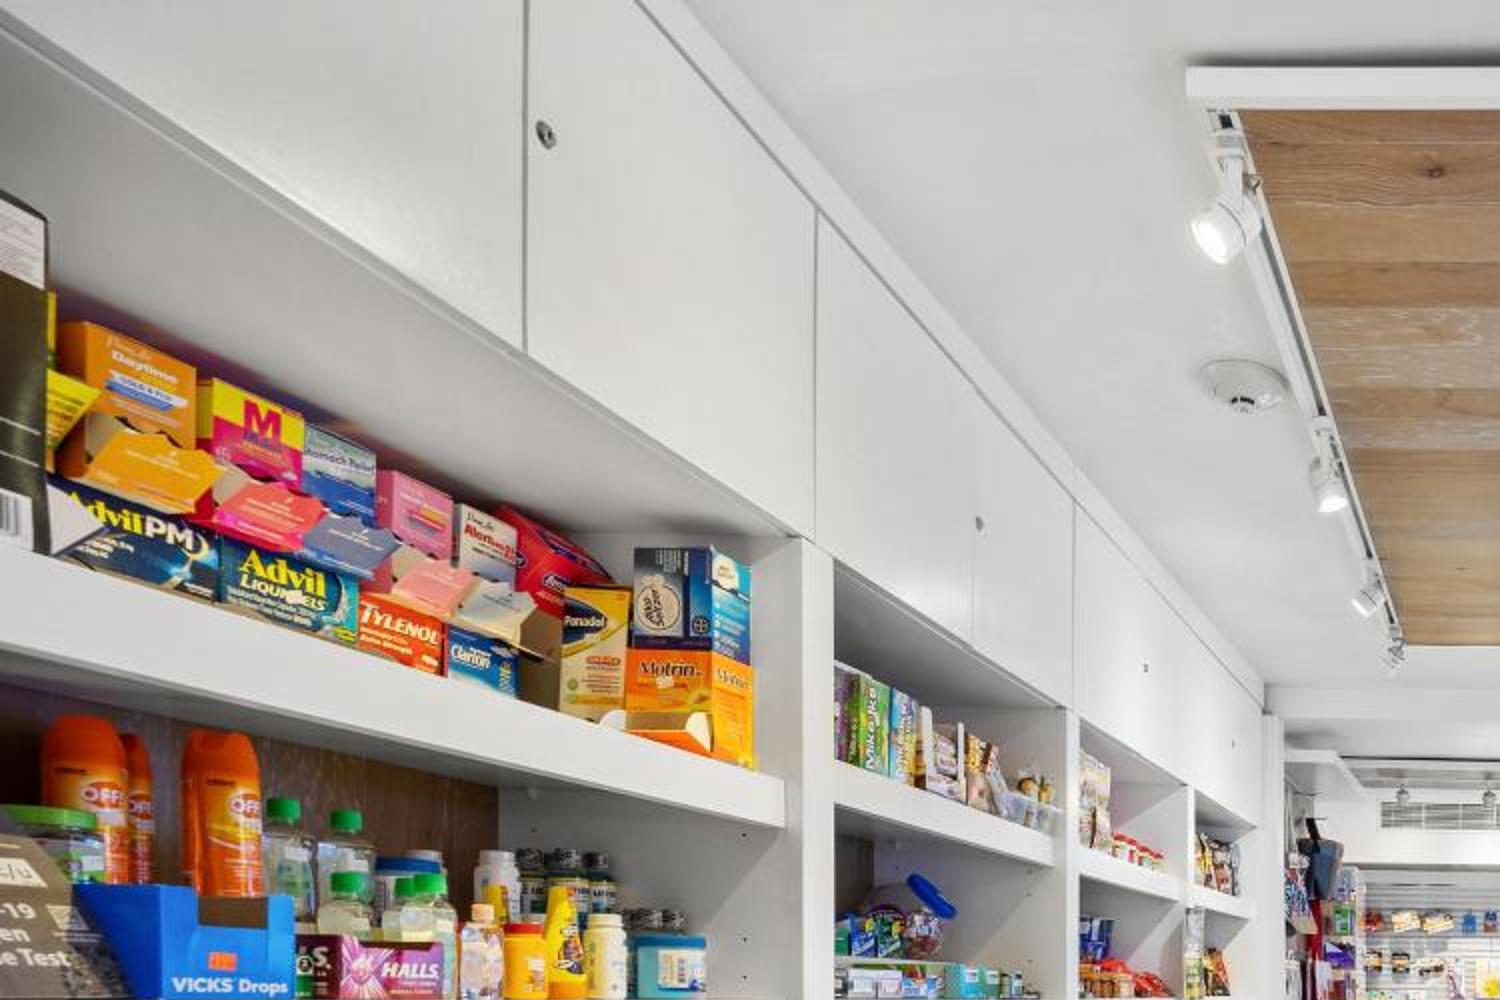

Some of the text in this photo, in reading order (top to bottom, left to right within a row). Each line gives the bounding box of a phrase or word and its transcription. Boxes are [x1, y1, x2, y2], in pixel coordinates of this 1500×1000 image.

[239, 549, 324, 599] Advil
[640, 660, 697, 677] Motrin
[381, 961, 441, 981] HALLS
[172, 976, 289, 997] VICKS Drops
